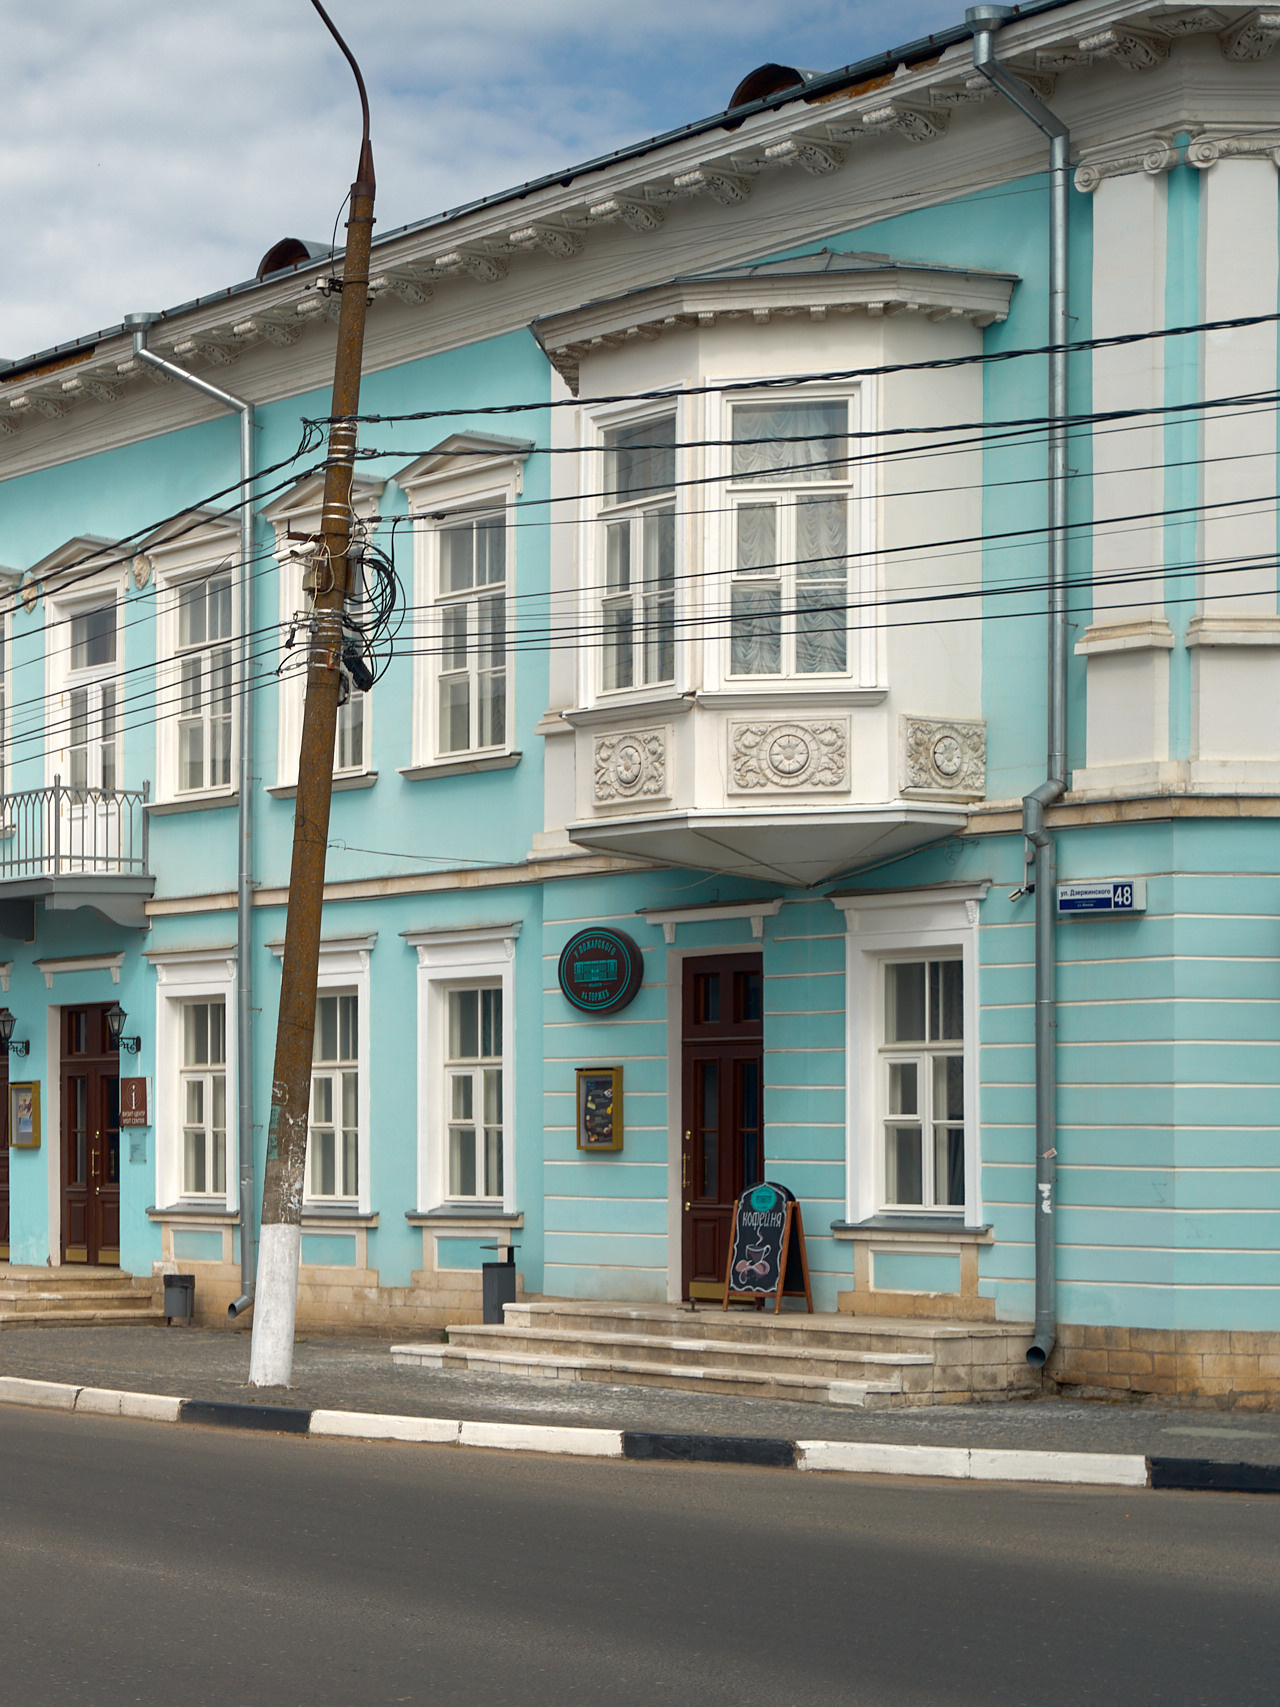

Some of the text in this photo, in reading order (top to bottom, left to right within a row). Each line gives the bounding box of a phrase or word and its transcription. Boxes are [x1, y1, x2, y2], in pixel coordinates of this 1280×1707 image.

[1070, 888, 1111, 897] Дзержинского
[1114, 886, 1131, 905] 48
[578, 940, 616, 956] ПОЖАРСКОГО
